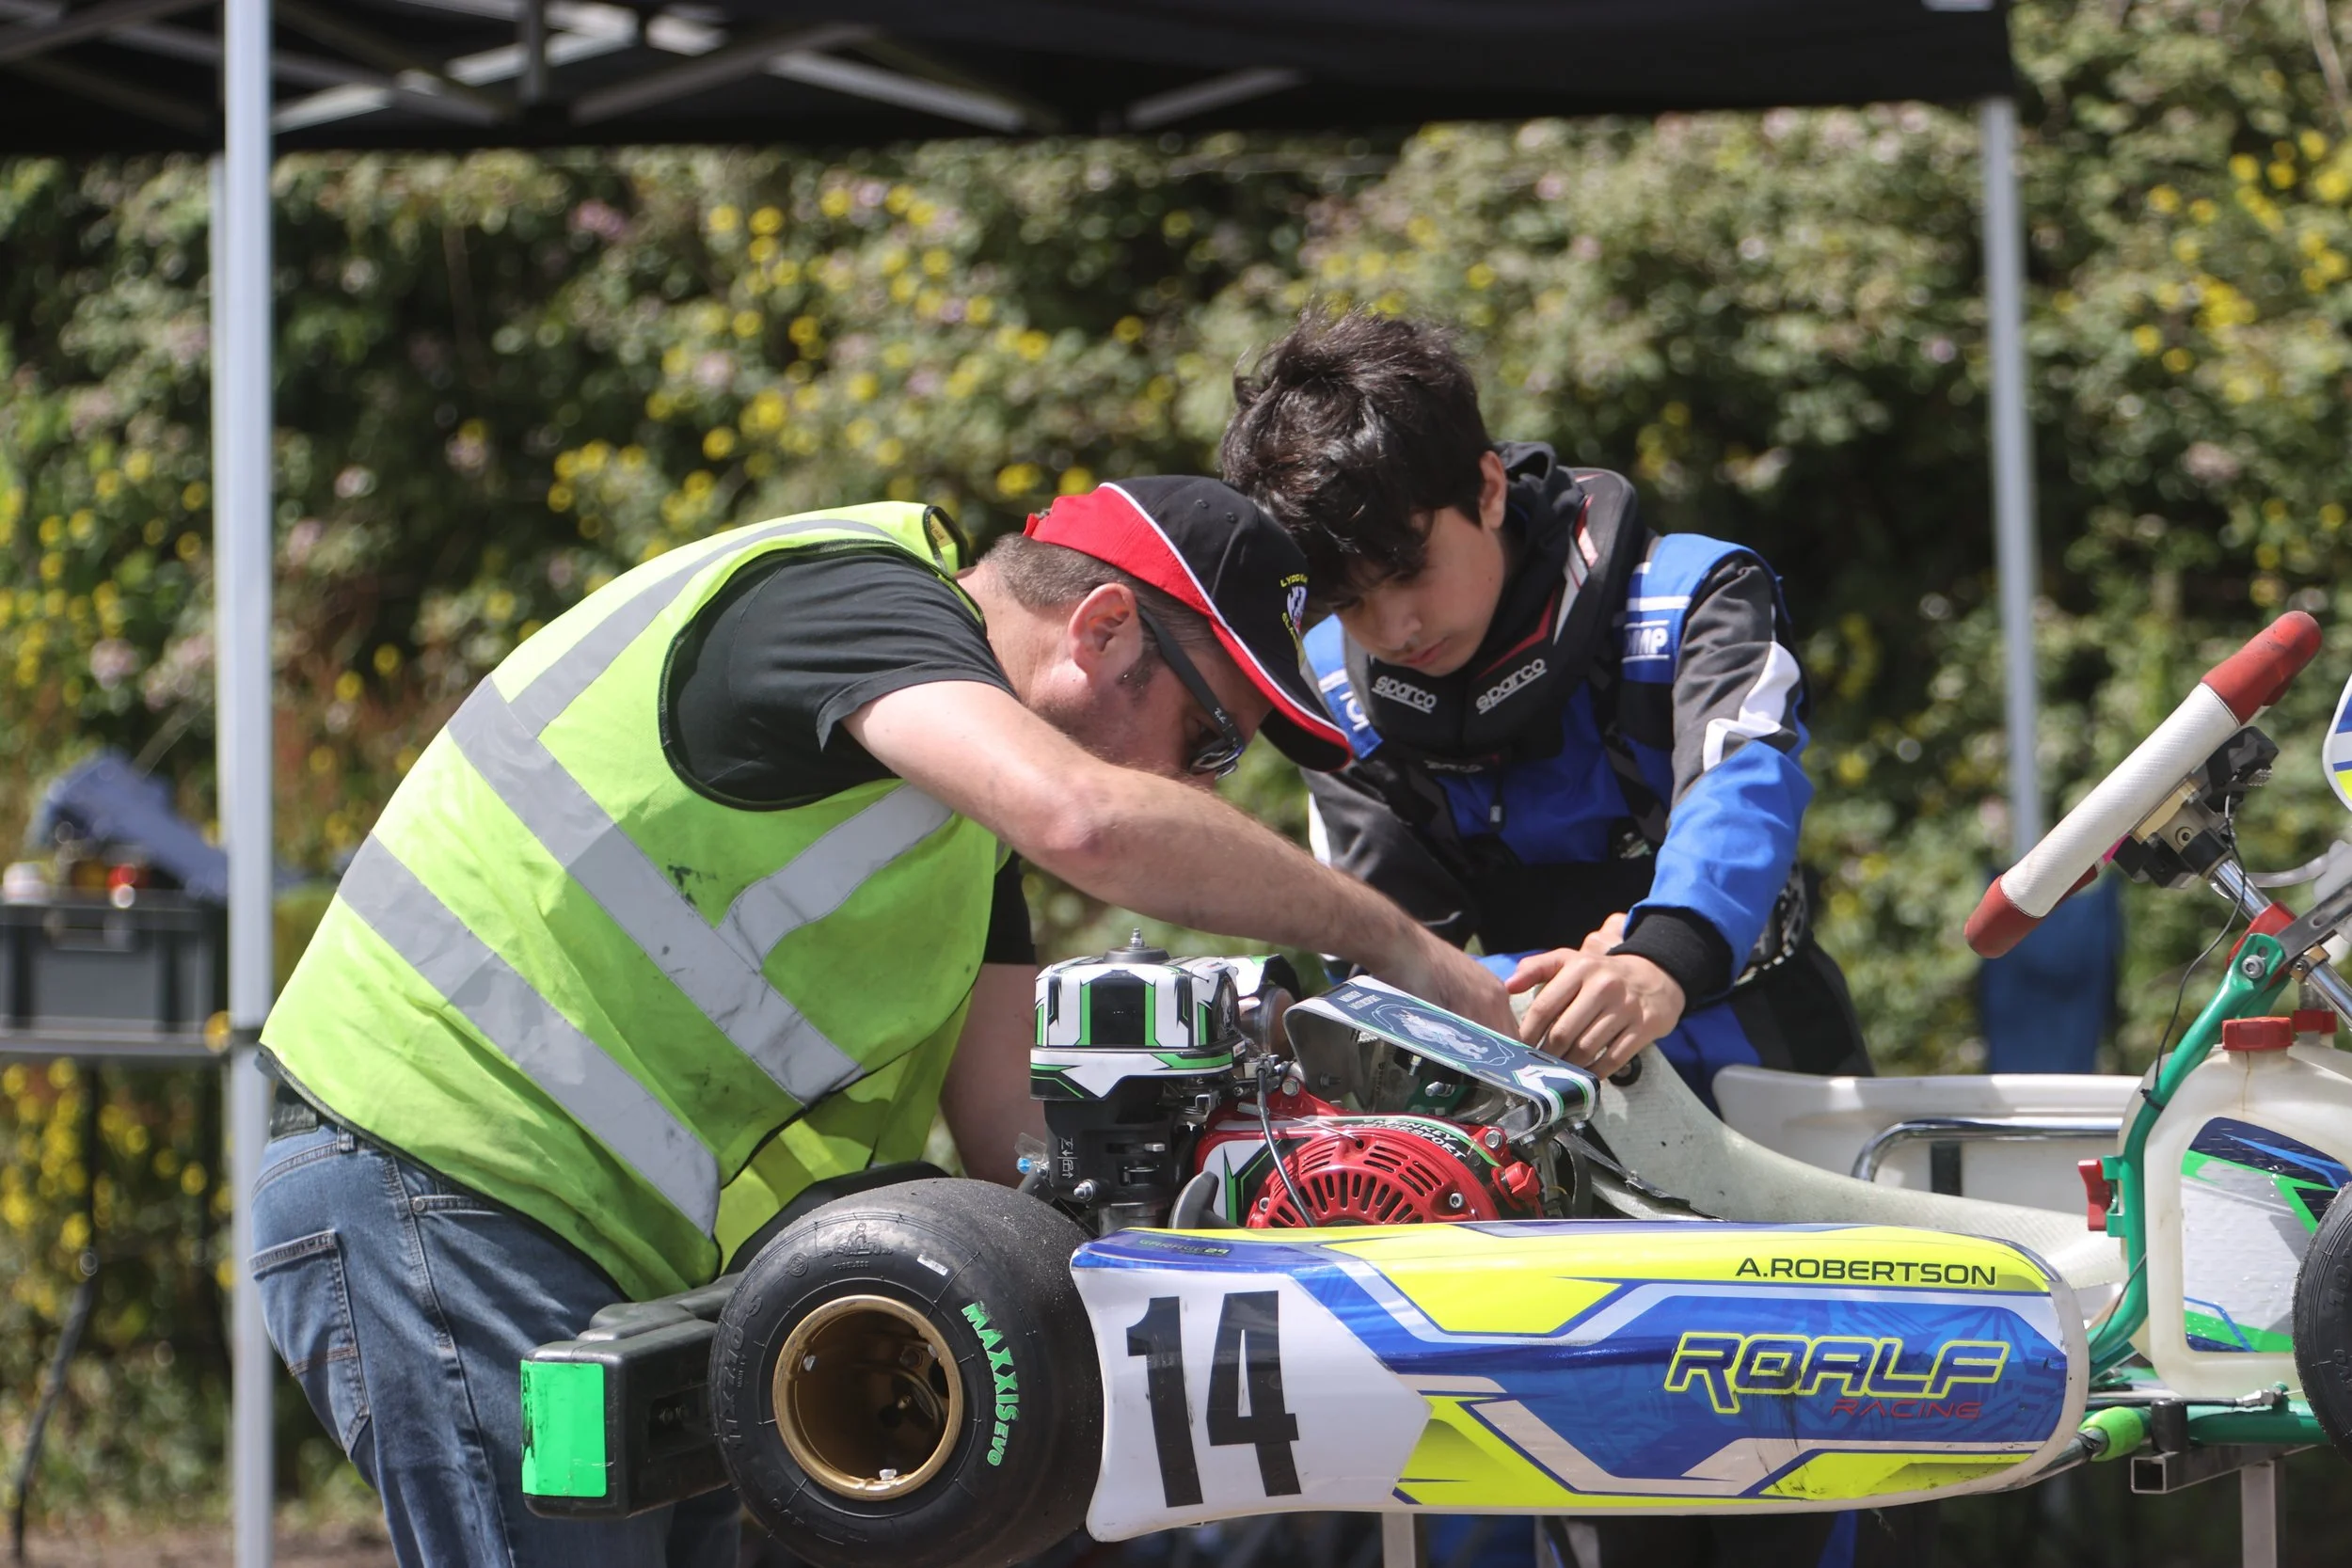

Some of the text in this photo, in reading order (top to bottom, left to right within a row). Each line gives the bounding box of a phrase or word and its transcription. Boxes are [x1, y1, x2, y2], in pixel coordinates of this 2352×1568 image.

[1372, 674, 1438, 714] sparco
[1476, 658, 1548, 715] sparco
[1735, 1257, 1996, 1287] A.ROBERTSON
[961, 1302, 1020, 1467] MAXXIS EVO
[1125, 1290, 1302, 1509] 14
[1663, 1330, 2011, 1415] ROALF
[1830, 1398, 1984, 1420] RACING
